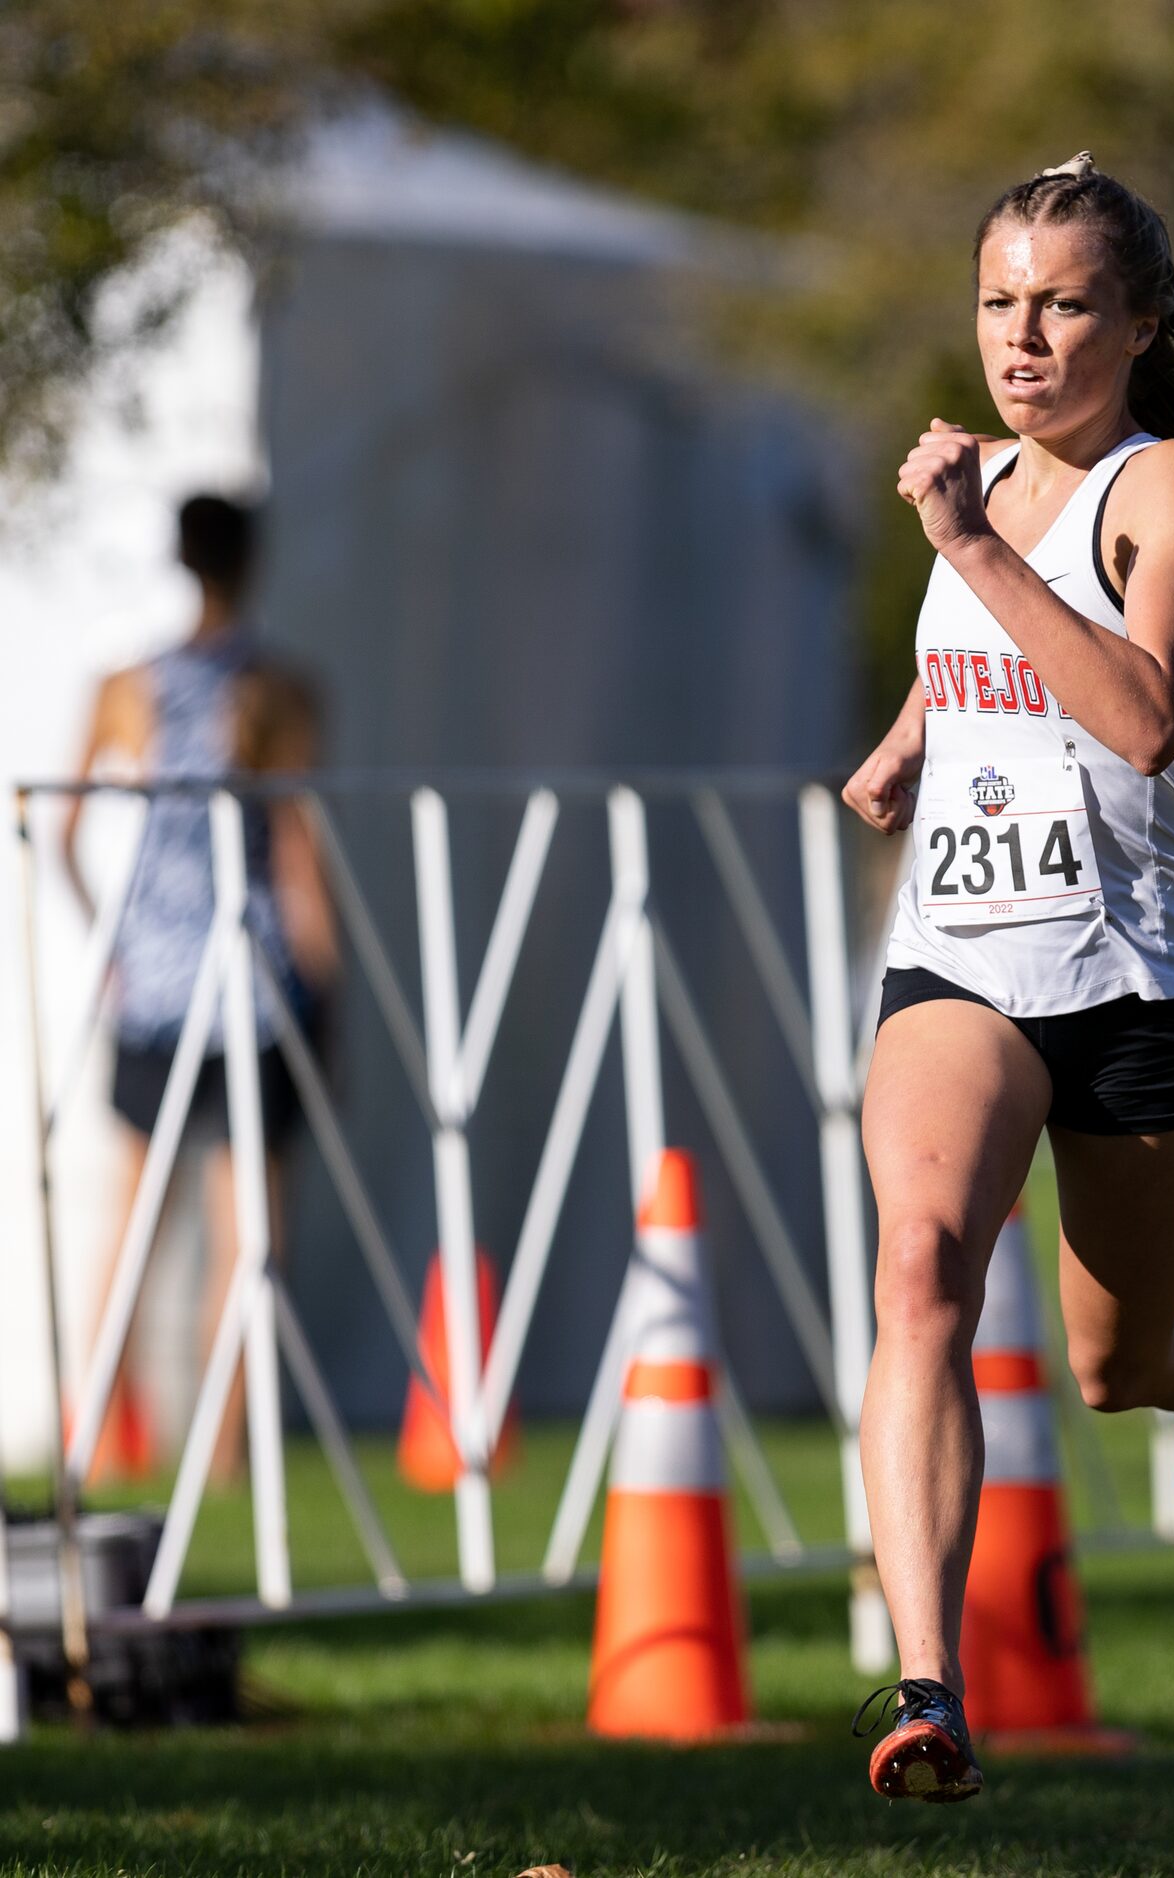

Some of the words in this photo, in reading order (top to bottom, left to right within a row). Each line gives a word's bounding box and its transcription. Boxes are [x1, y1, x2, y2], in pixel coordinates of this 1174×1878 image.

[916, 649, 1073, 719] OVEJO
[969, 785, 1015, 800] STATE
[930, 819, 1082, 896] 2314
[989, 904, 1013, 914] 2022
